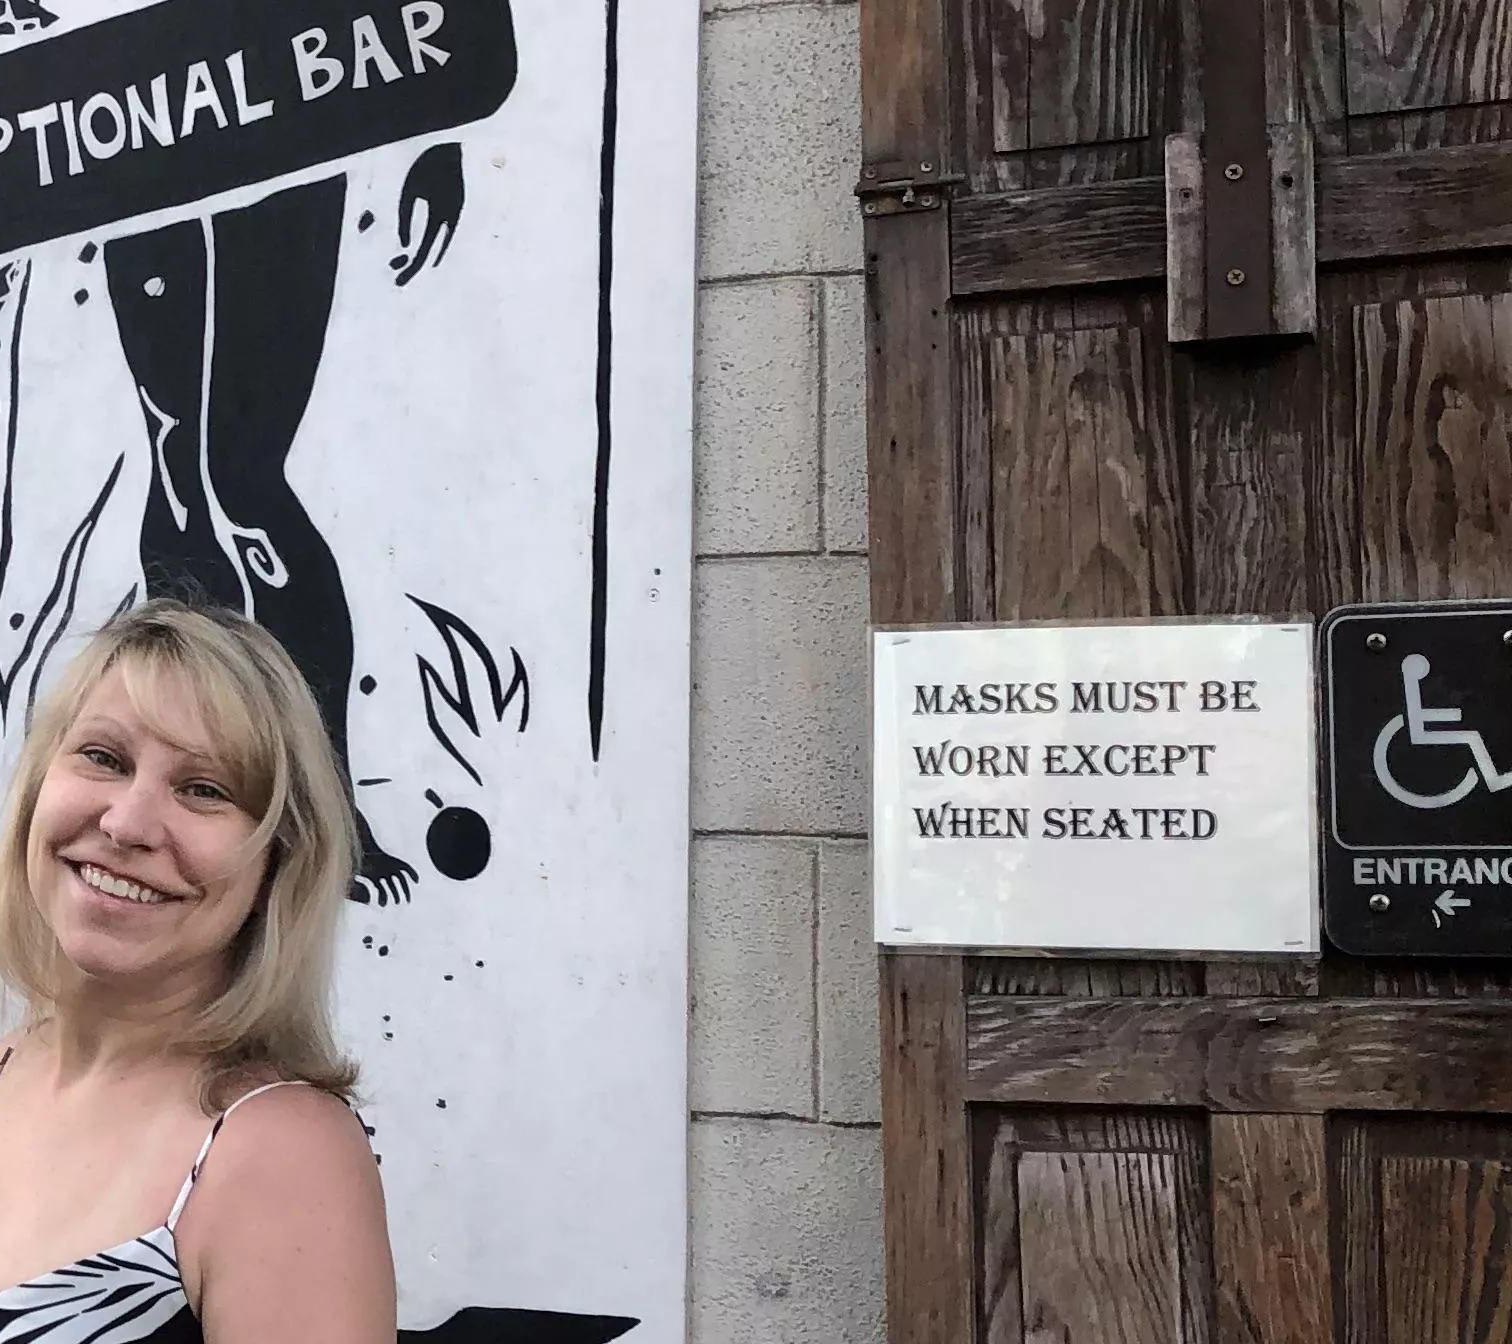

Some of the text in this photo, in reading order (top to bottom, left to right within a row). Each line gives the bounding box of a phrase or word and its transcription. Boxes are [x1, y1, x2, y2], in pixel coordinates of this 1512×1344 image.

[291, 0, 451, 102] BAR
[912, 679, 1262, 716] MASKS MUST BE
[912, 739, 1217, 778] WORN EXCEPT
[912, 801, 1218, 841] WHEN SEATED
